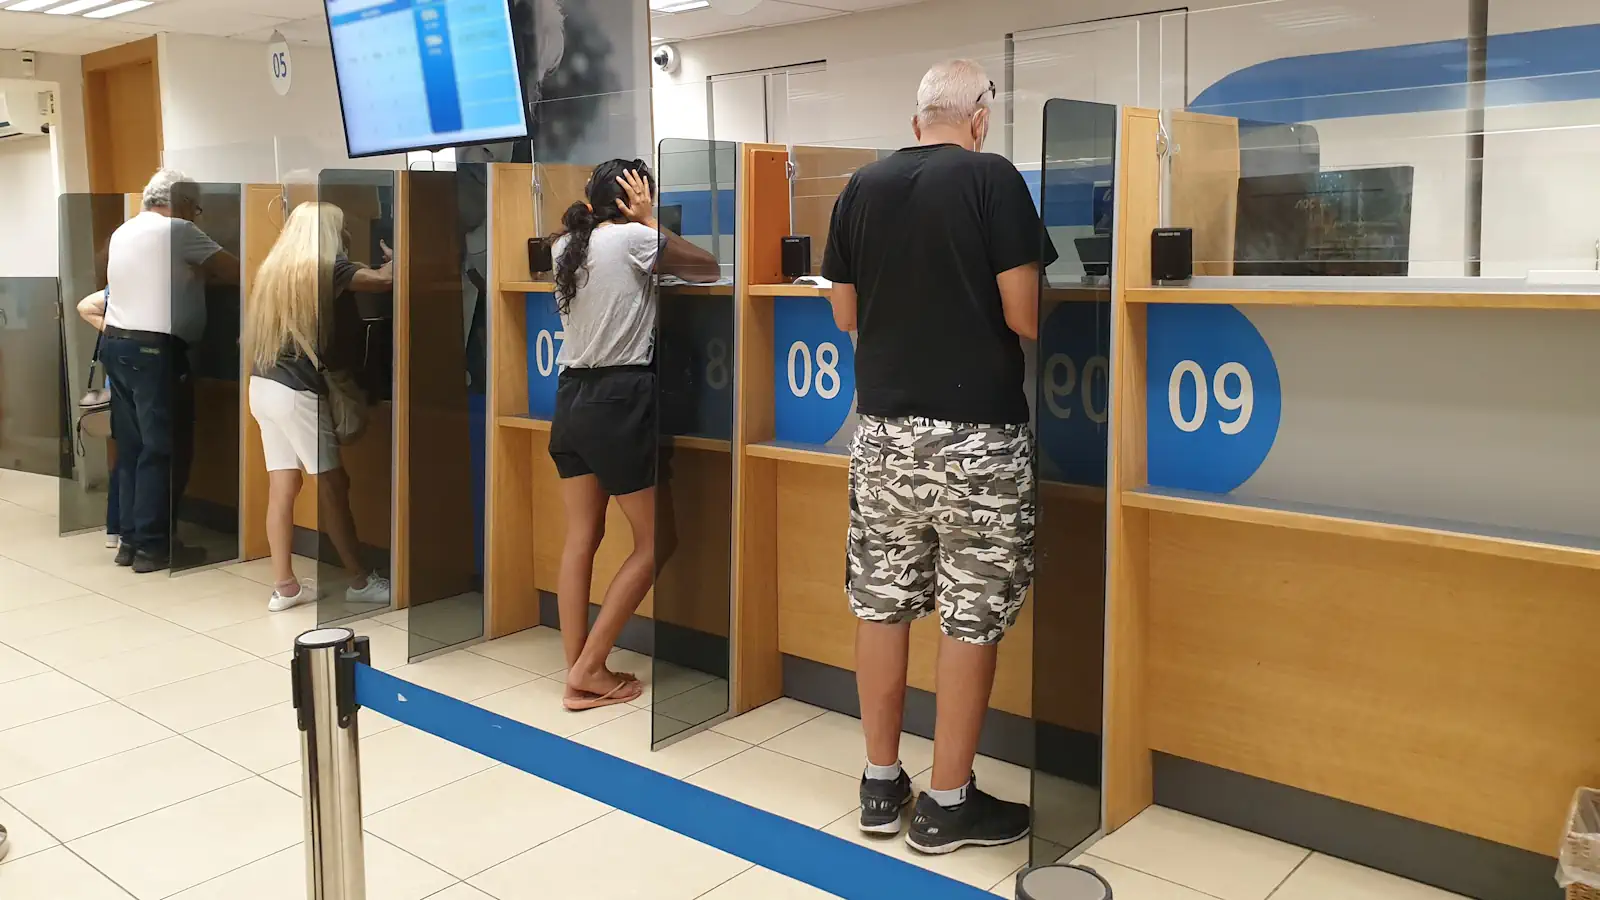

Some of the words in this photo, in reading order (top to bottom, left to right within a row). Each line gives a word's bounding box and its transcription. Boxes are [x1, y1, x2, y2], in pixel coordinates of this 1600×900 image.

[273, 52, 287, 78] 05
[787, 340, 841, 400] 08
[1168, 359, 1254, 435] 09
